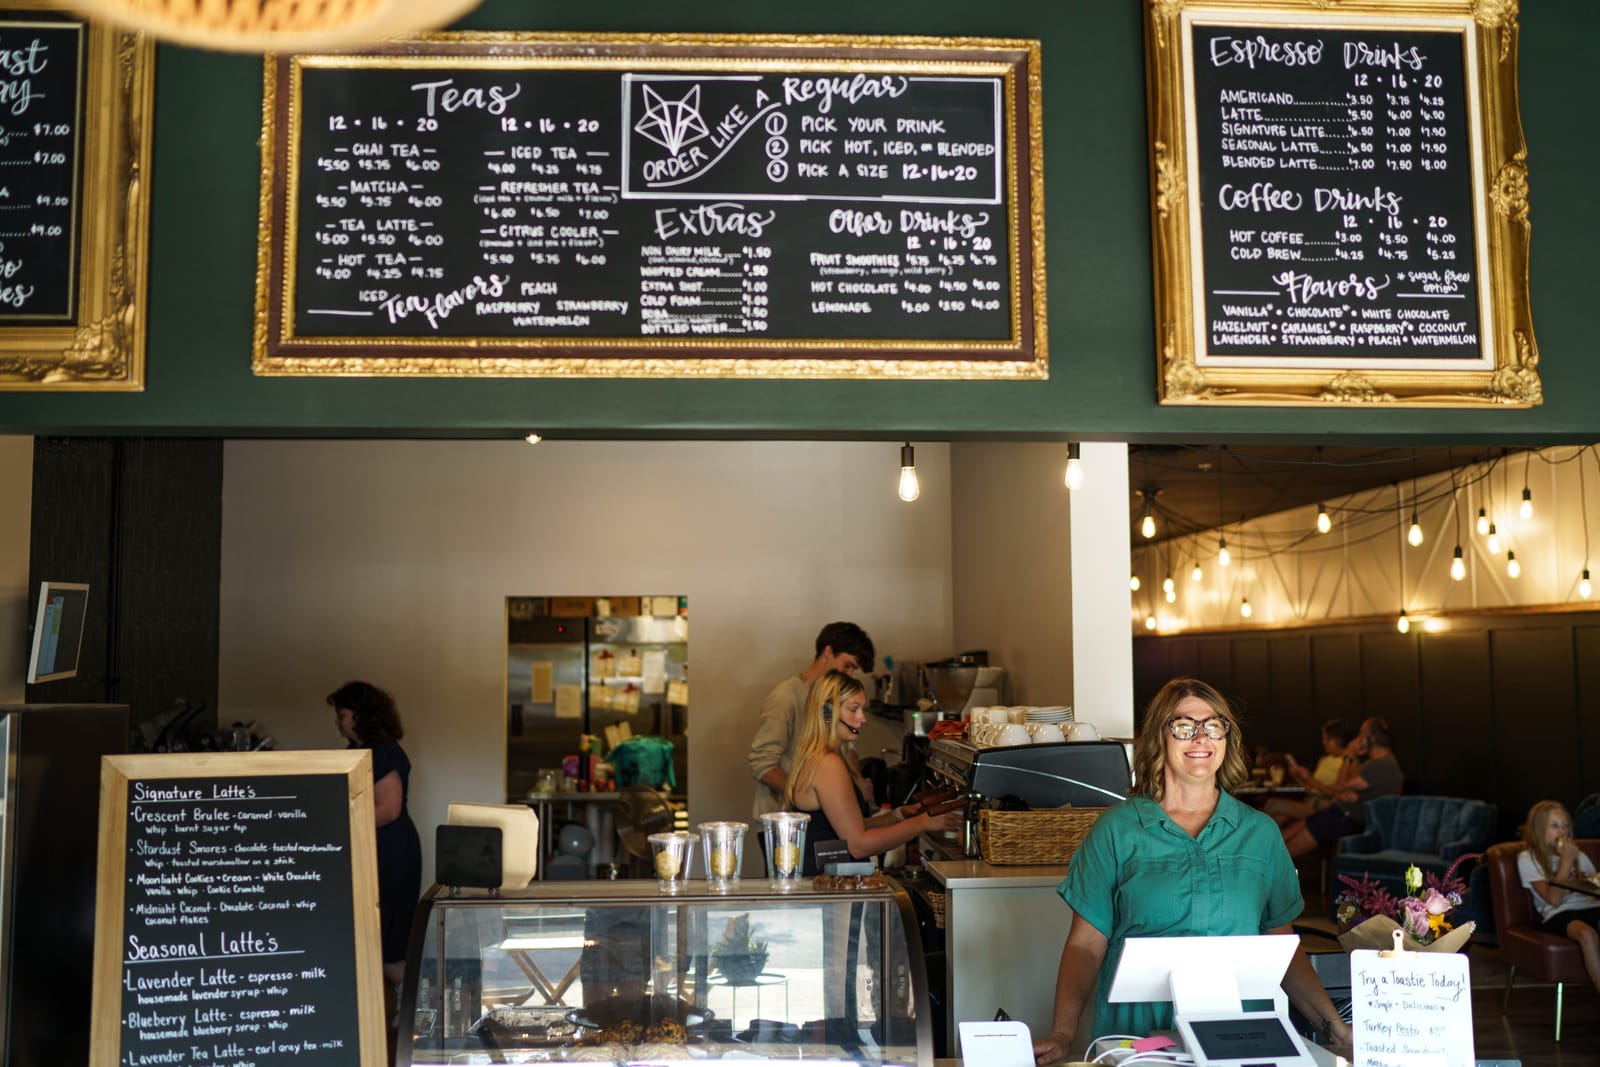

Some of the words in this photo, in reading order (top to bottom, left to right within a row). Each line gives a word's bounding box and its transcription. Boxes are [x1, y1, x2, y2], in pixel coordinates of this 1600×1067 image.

[1210, 35, 1323, 69] Espresso
[1343, 42, 1428, 70] Drinks
[1354, 73, 1368, 87] 12
[1392, 73, 1408, 88] 16
[1424, 74, 1443, 88] 20
[411, 79, 521, 116] Teas
[782, 73, 908, 114] Regular
[1220, 89, 1294, 105] AMERICANO
[1346, 92, 1373, 105] $3.50
[1386, 92, 1410, 106] $3.75
[1221, 106, 1263, 121] LATTE
[34, 124, 70, 136] $7.00
[329, 116, 347, 131] 12
[371, 116, 388, 130] 16
[416, 118, 438, 131] 20
[501, 117, 518, 132] 12
[539, 117, 556, 133] 16
[577, 119, 599, 133] 20
[802, 115, 837, 133] PICK
[848, 116, 887, 133] YOUR
[896, 118, 946, 134] DRINK
[1221, 122, 1287, 137] SIGNATURE
[1291, 126, 1325, 138] LATTE
[643, 146, 709, 181] ORDER
[710, 104, 749, 149] LIKE
[757, 88, 770, 108] A
[352, 143, 383, 156] CHAI
[390, 144, 420, 157] TEA
[511, 146, 542, 159] ICED
[550, 147, 577, 159] TEA
[799, 139, 833, 154] PICK
[937, 142, 995, 157] BLENDED
[1221, 138, 1277, 152] SEASONAL
[1281, 141, 1320, 153] LATTE
[34, 151, 66, 165] $7.00
[1222, 155, 1275, 168] BLENDED
[1280, 158, 1318, 170] LATTE
[798, 162, 829, 178] PICK
[838, 164, 849, 178] A
[856, 164, 888, 179] SIZE
[350, 180, 408, 194] MATCHA
[573, 182, 599, 194] TEA
[1218, 182, 1302, 212] Coffee
[1314, 186, 1403, 216] Drinks
[339, 219, 365, 231] TEA
[376, 219, 418, 232] LATTE
[654, 202, 776, 240] Extras
[829, 209, 892, 238] Other
[900, 209, 990, 238] Drinks
[1343, 214, 1358, 228] 12
[1388, 215, 1403, 229] 16
[1428, 215, 1448, 228] 20
[499, 224, 544, 237] CITRUS
[550, 226, 599, 238] COOLER
[1230, 229, 1255, 243] HOT
[1260, 231, 1304, 245] COFFEE
[1335, 230, 1363, 243] $3.00
[1379, 232, 1408, 245] $3.50
[1426, 231, 1456, 244] $4.00
[906, 236, 922, 249] 12
[944, 237, 957, 250] 16
[972, 237, 992, 250] 20
[338, 254, 366, 266] HOT
[375, 252, 407, 265] TEA
[810, 252, 841, 266] FRUIT
[1230, 246, 1262, 260] COLD
[1267, 249, 1301, 260] BREW
[1335, 248, 1364, 260] $4.25
[1378, 247, 1408, 260] $4.75
[1427, 247, 1456, 260] $5.25
[521, 282, 557, 296] PEACH
[811, 281, 833, 292] HOT
[838, 282, 898, 295] CHOCOLATE
[1272, 270, 1390, 304] Flavors
[359, 290, 388, 302] ICED
[424, 274, 510, 329] Flavors
[476, 302, 540, 315] RASPBERRY
[556, 300, 628, 315] STRAWBERRY
[812, 301, 872, 313] LEMONADE
[1362, 308, 1392, 319] WHITE
[1397, 309, 1450, 320] CHOCOLATE
[513, 315, 590, 327] WATERMELON
[1213, 321, 1270, 333] HAZELNUT
[1419, 321, 1467, 333] COCONUT
[1213, 335, 1271, 346] LAVENDER
[1281, 335, 1355, 347] STRAWBERRY
[1368, 336, 1401, 346] PEACH
[1411, 334, 1477, 346] WATERMELON
[134, 782, 202, 802] Signature
[213, 784, 256, 799] Latte's
[134, 806, 187, 823] Crescent
[193, 807, 230, 821] Brulee
[145, 825, 167, 837] whip
[202, 825, 230, 835] sugar
[233, 823, 247, 834] top
[136, 838, 181, 856] Stardust
[189, 840, 227, 855] Smores
[144, 859, 164, 870] whip
[222, 874, 252, 882] Cream
[176, 886, 198, 897] whip
[180, 915, 209, 925] flakes
[129, 932, 206, 961] Seasonal
[221, 931, 279, 955] Latte's
[127, 969, 195, 991] Lavender
[200, 968, 237, 986] Latte
[248, 972, 293, 985] espresso
[301, 966, 326, 979] milk
[1358, 970, 1379, 997] Try
[1381, 976, 1389, 985] a
[1390, 970, 1426, 988] Toastie
[1428, 971, 1466, 1002] Today!
[137, 990, 188, 1005] housemade
[230, 989, 260, 999] syrup
[266, 985, 288, 996] whip
[128, 1010, 186, 1033] Blueberry
[195, 1008, 227, 1023] Latte
[240, 1010, 280, 1020] espresso
[290, 1004, 316, 1016] milk
[193, 1025, 232, 1036] blueberry
[268, 1020, 288, 1031] whip
[1363, 1019, 1392, 1038] Turkey
[1396, 1022, 1419, 1036] Pesto
[129, 1049, 186, 1067] Lavender
[190, 1046, 208, 1060] Tea
[214, 1042, 245, 1059] Latte
[255, 1040, 276, 1054] earl
[303, 1040, 317, 1050] tea
[322, 1040, 344, 1048] milk
[1365, 1042, 1396, 1054] Toasted
